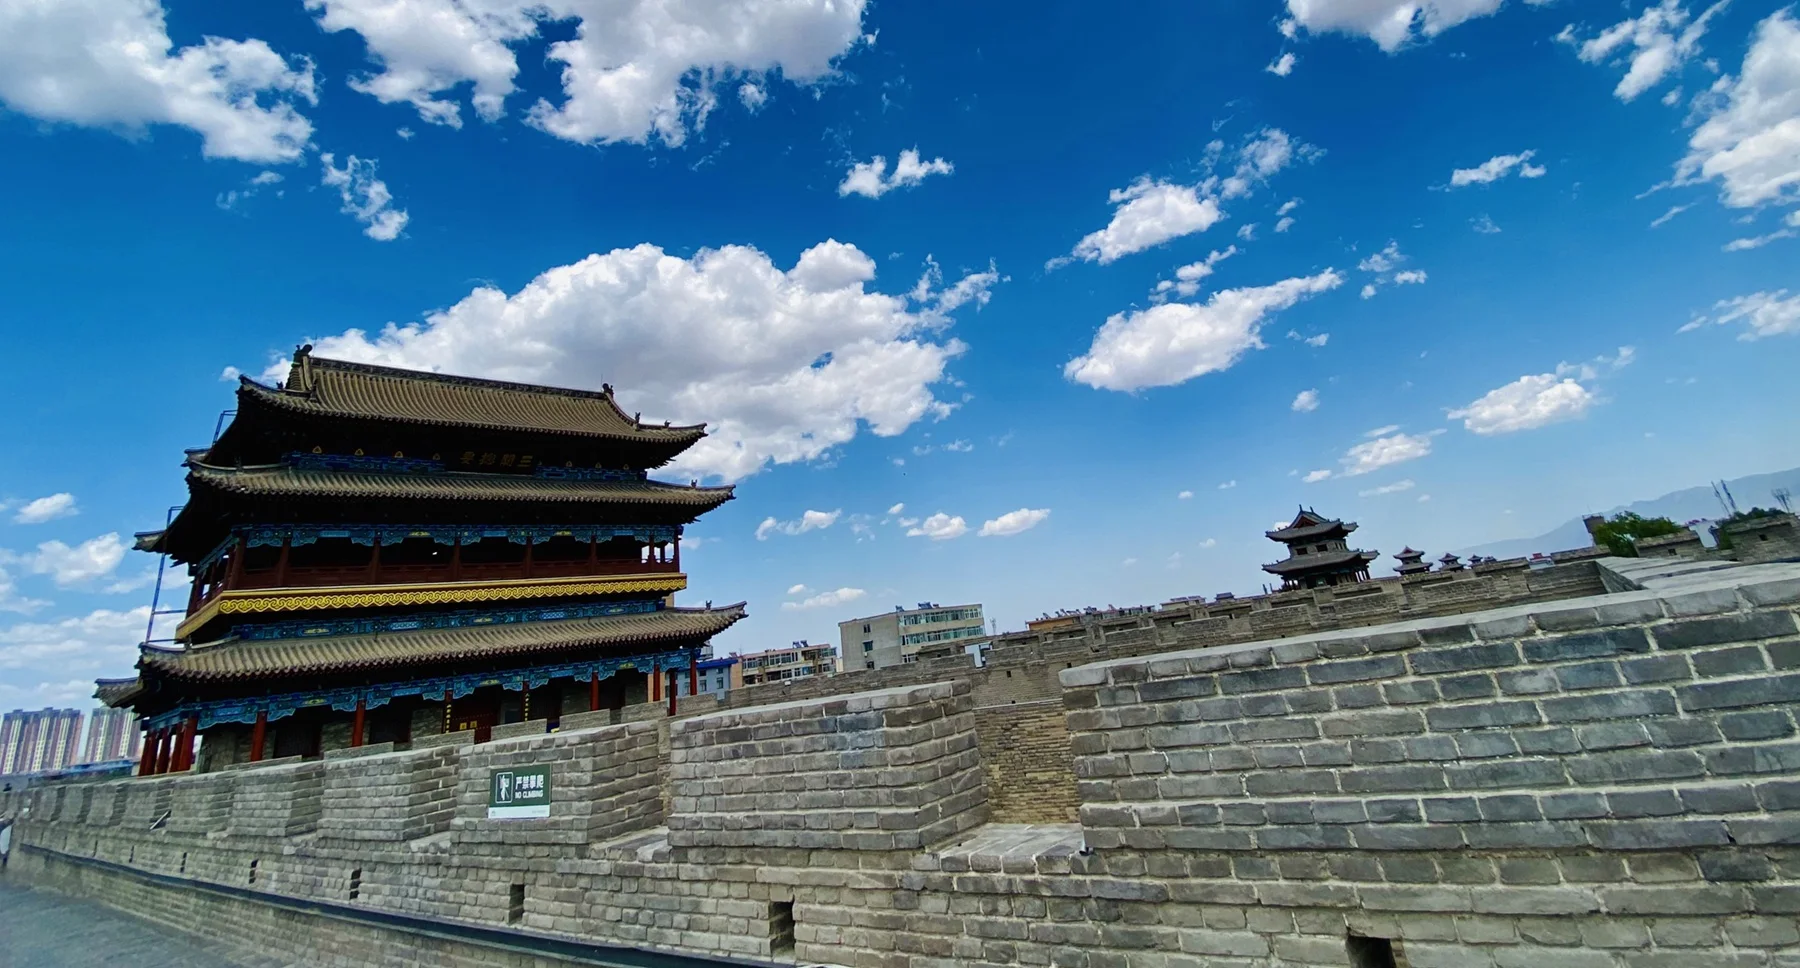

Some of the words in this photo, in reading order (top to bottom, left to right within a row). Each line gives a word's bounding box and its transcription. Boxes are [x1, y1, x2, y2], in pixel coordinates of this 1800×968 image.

[515, 775, 544, 790] 严禁攀爬
[515, 791, 522, 799] NO
[523, 790, 544, 799] CLIMBING
